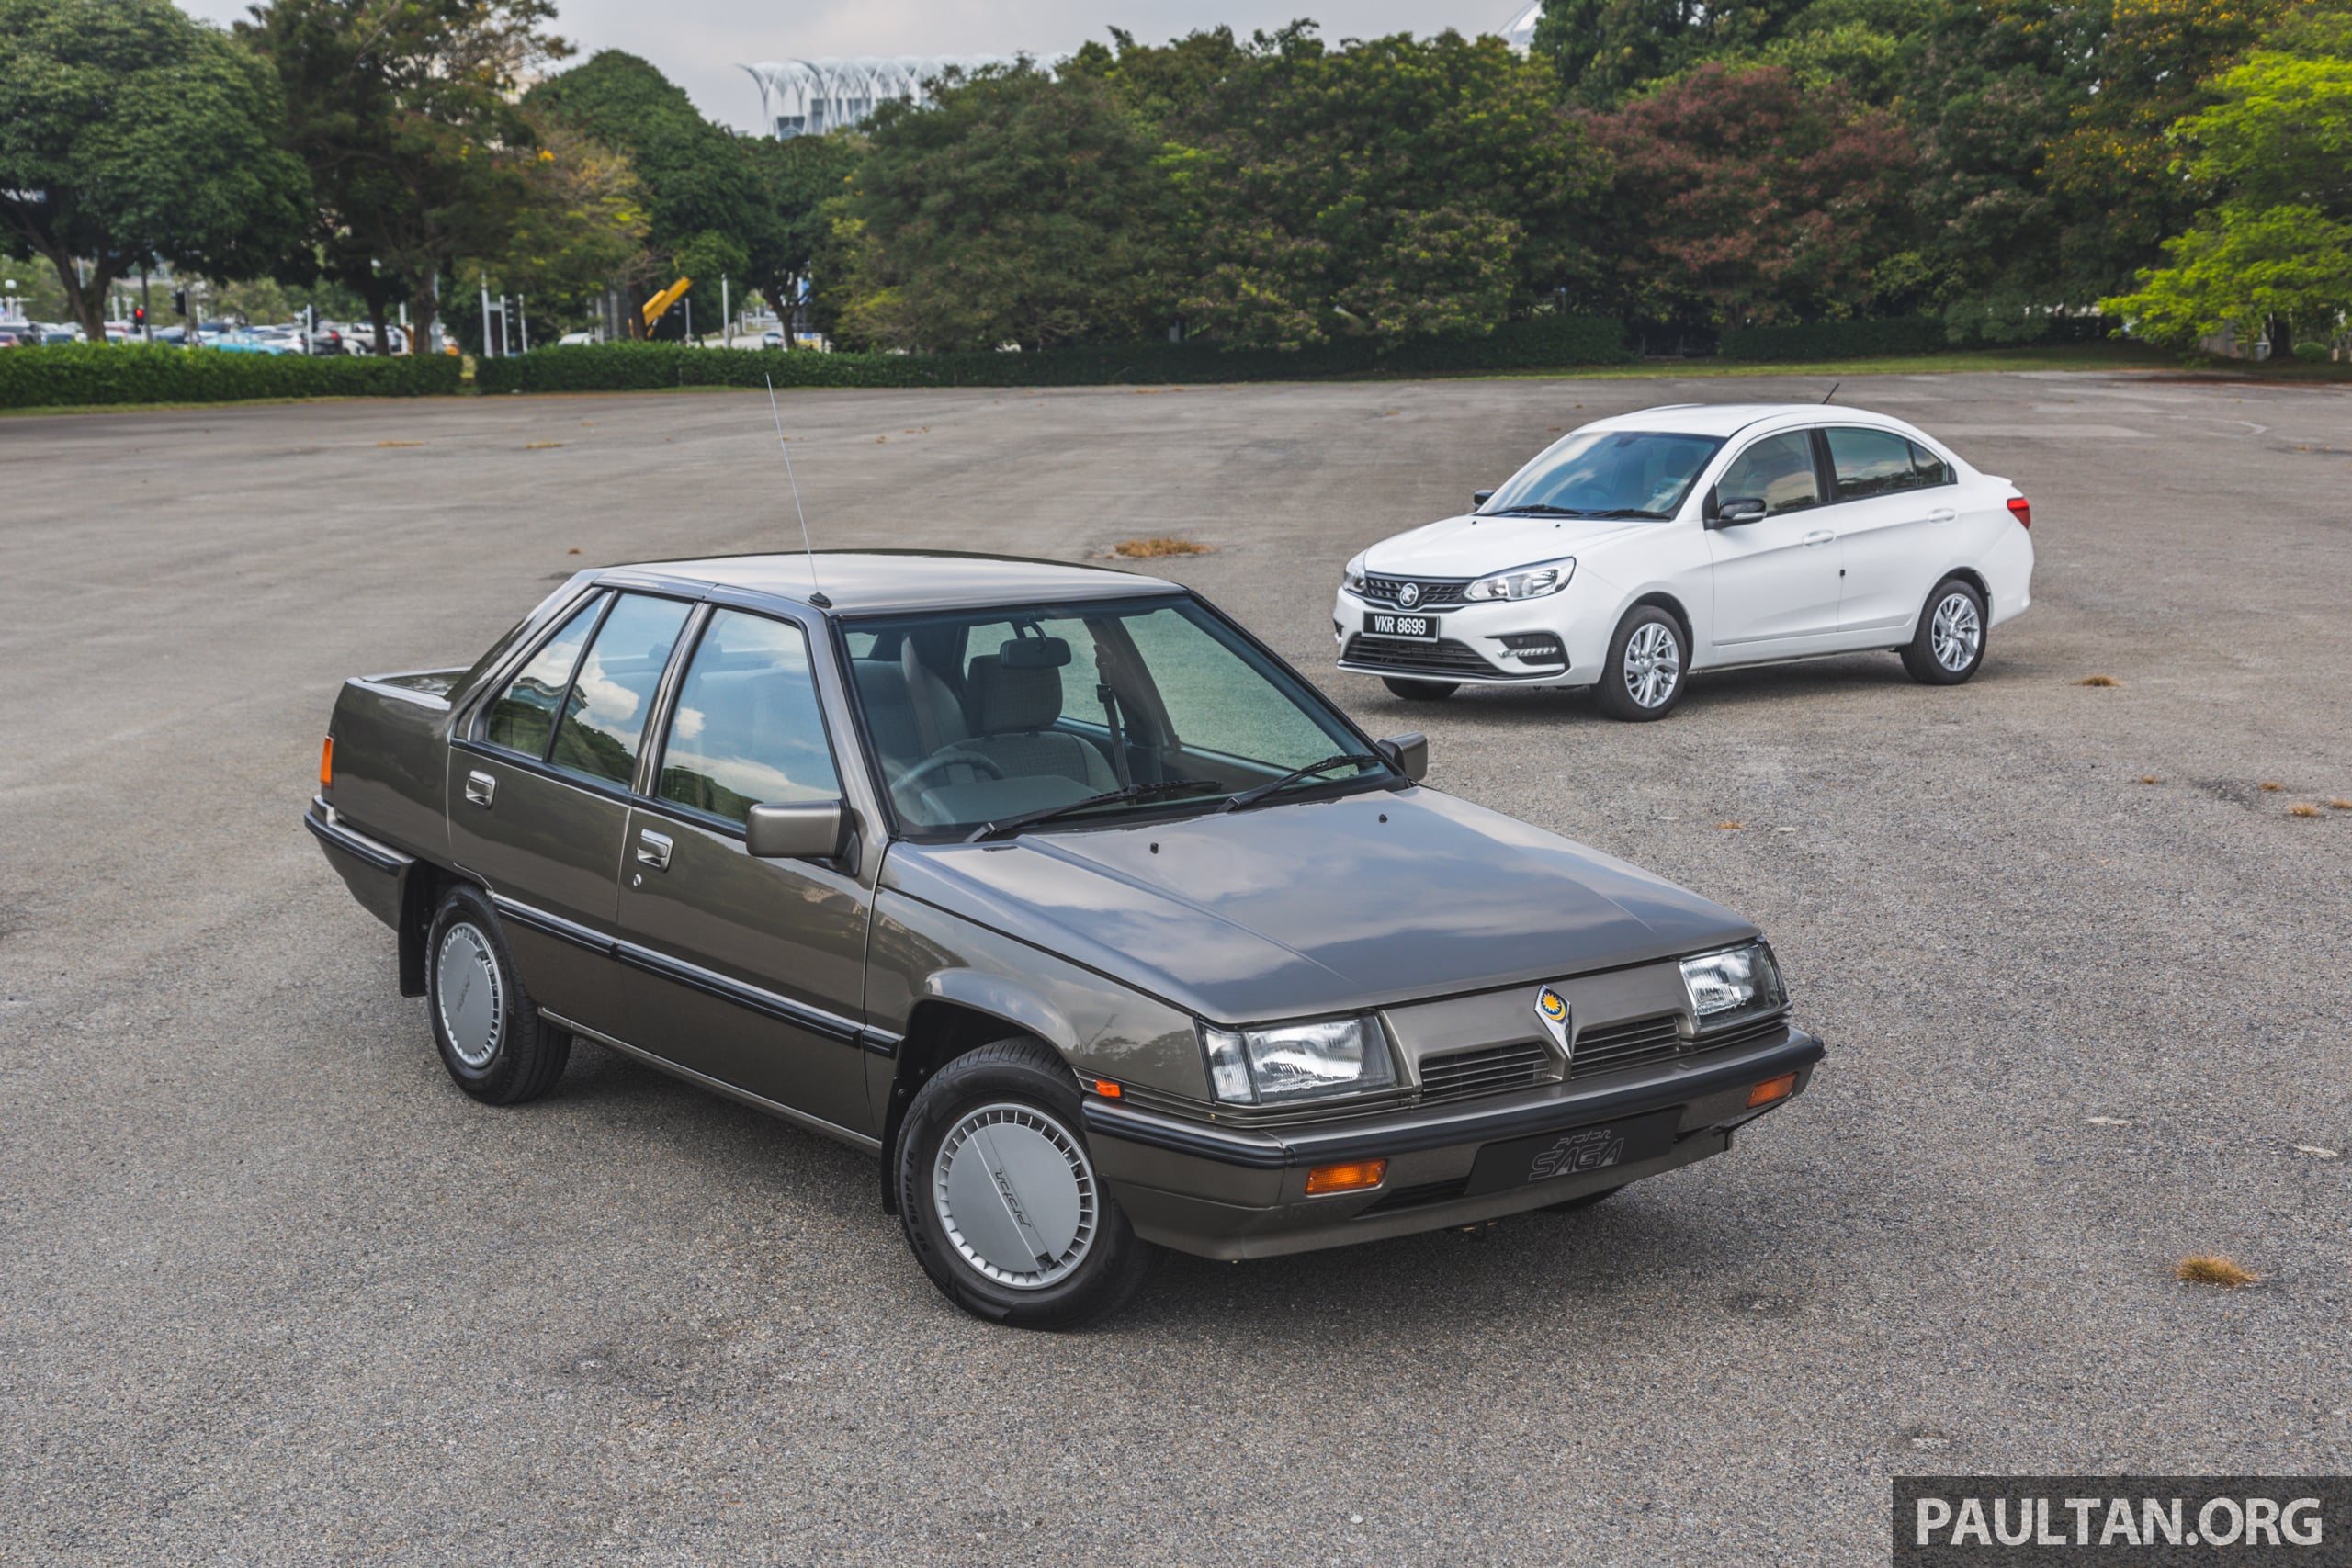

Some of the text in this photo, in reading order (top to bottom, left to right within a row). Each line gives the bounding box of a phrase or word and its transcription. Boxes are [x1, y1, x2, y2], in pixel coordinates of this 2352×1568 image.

[1374, 615, 1426, 635] VKR 8699
[1528, 1137, 1625, 1181] SAGA
